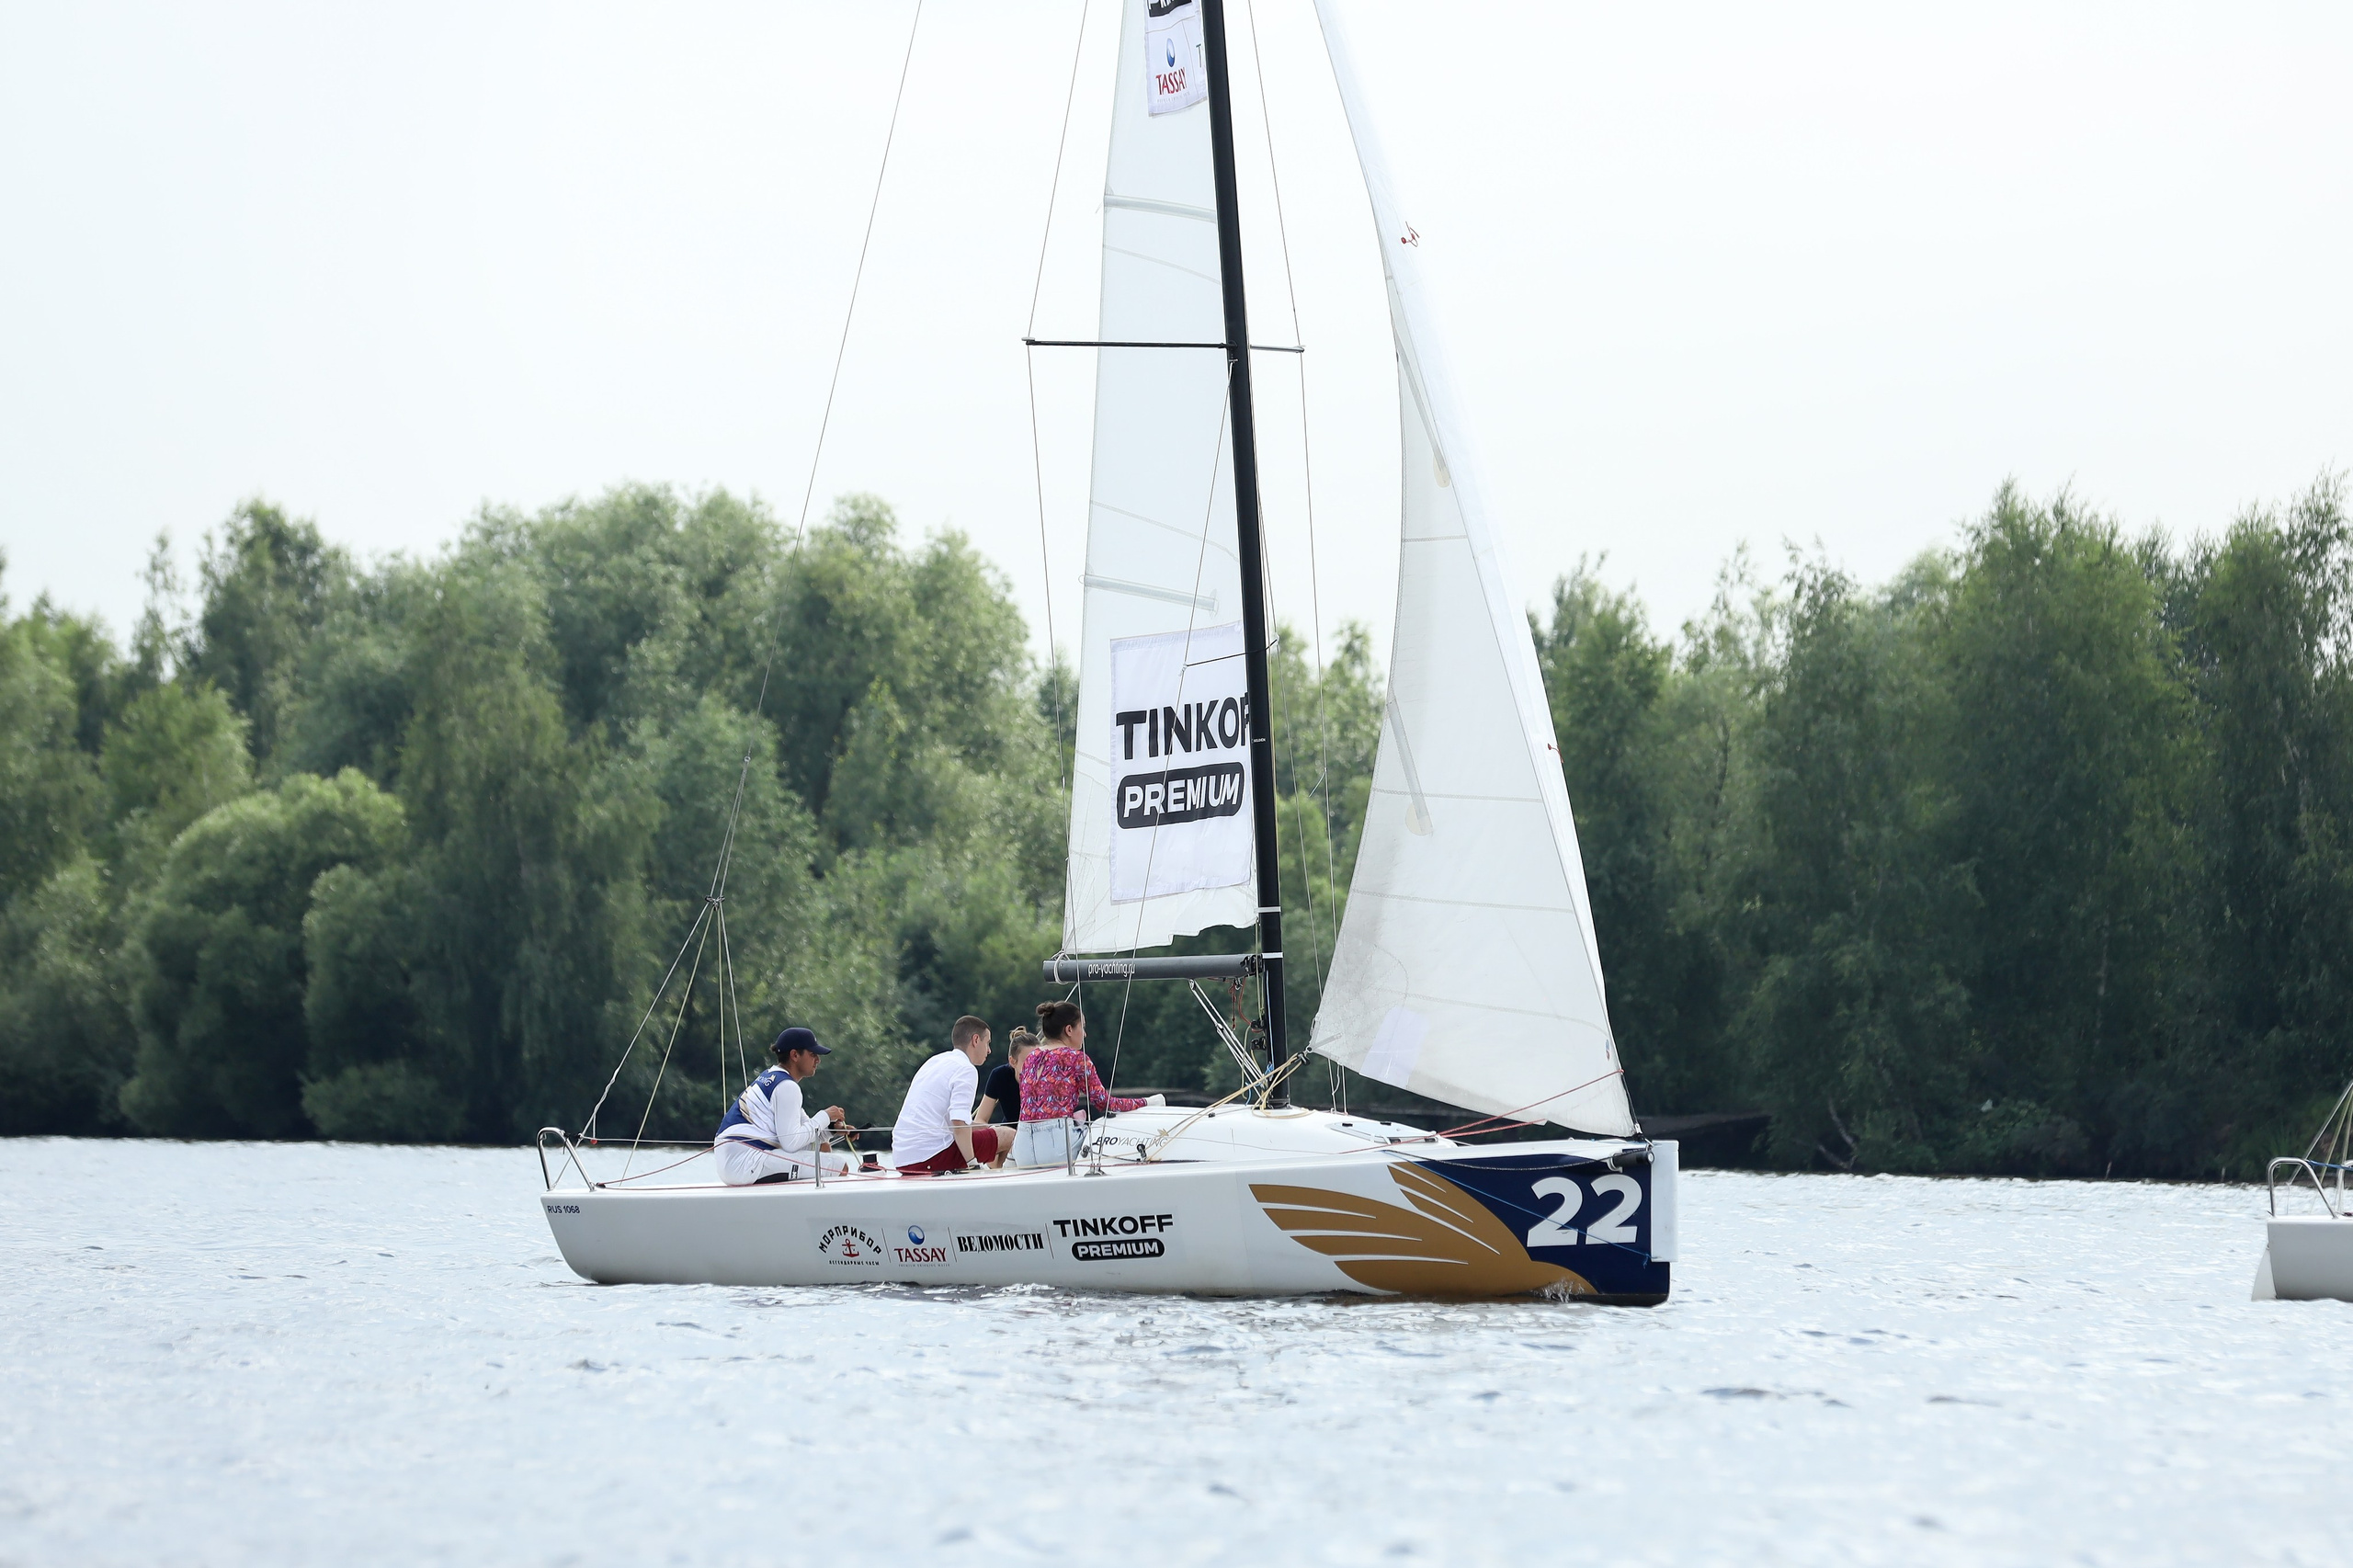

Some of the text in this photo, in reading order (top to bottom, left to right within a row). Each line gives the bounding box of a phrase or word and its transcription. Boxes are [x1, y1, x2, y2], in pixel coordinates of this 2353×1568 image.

[1155, 67, 1188, 96] TASSAY
[1123, 773, 1241, 818] PREMIUM
[1088, 960, 1136, 978] pro-yachting.ru
[547, 1205, 581, 1214] RUS 1068
[1527, 1174, 1643, 1247] 22
[1052, 1214, 1173, 1238] TINKOFF
[818, 1225, 882, 1255] МОРПРИБОР
[957, 1233, 1044, 1254] ВЕДОМОСТИ
[1076, 1242, 1159, 1258] PREMIUM
[893, 1247, 947, 1263] TASSAY
